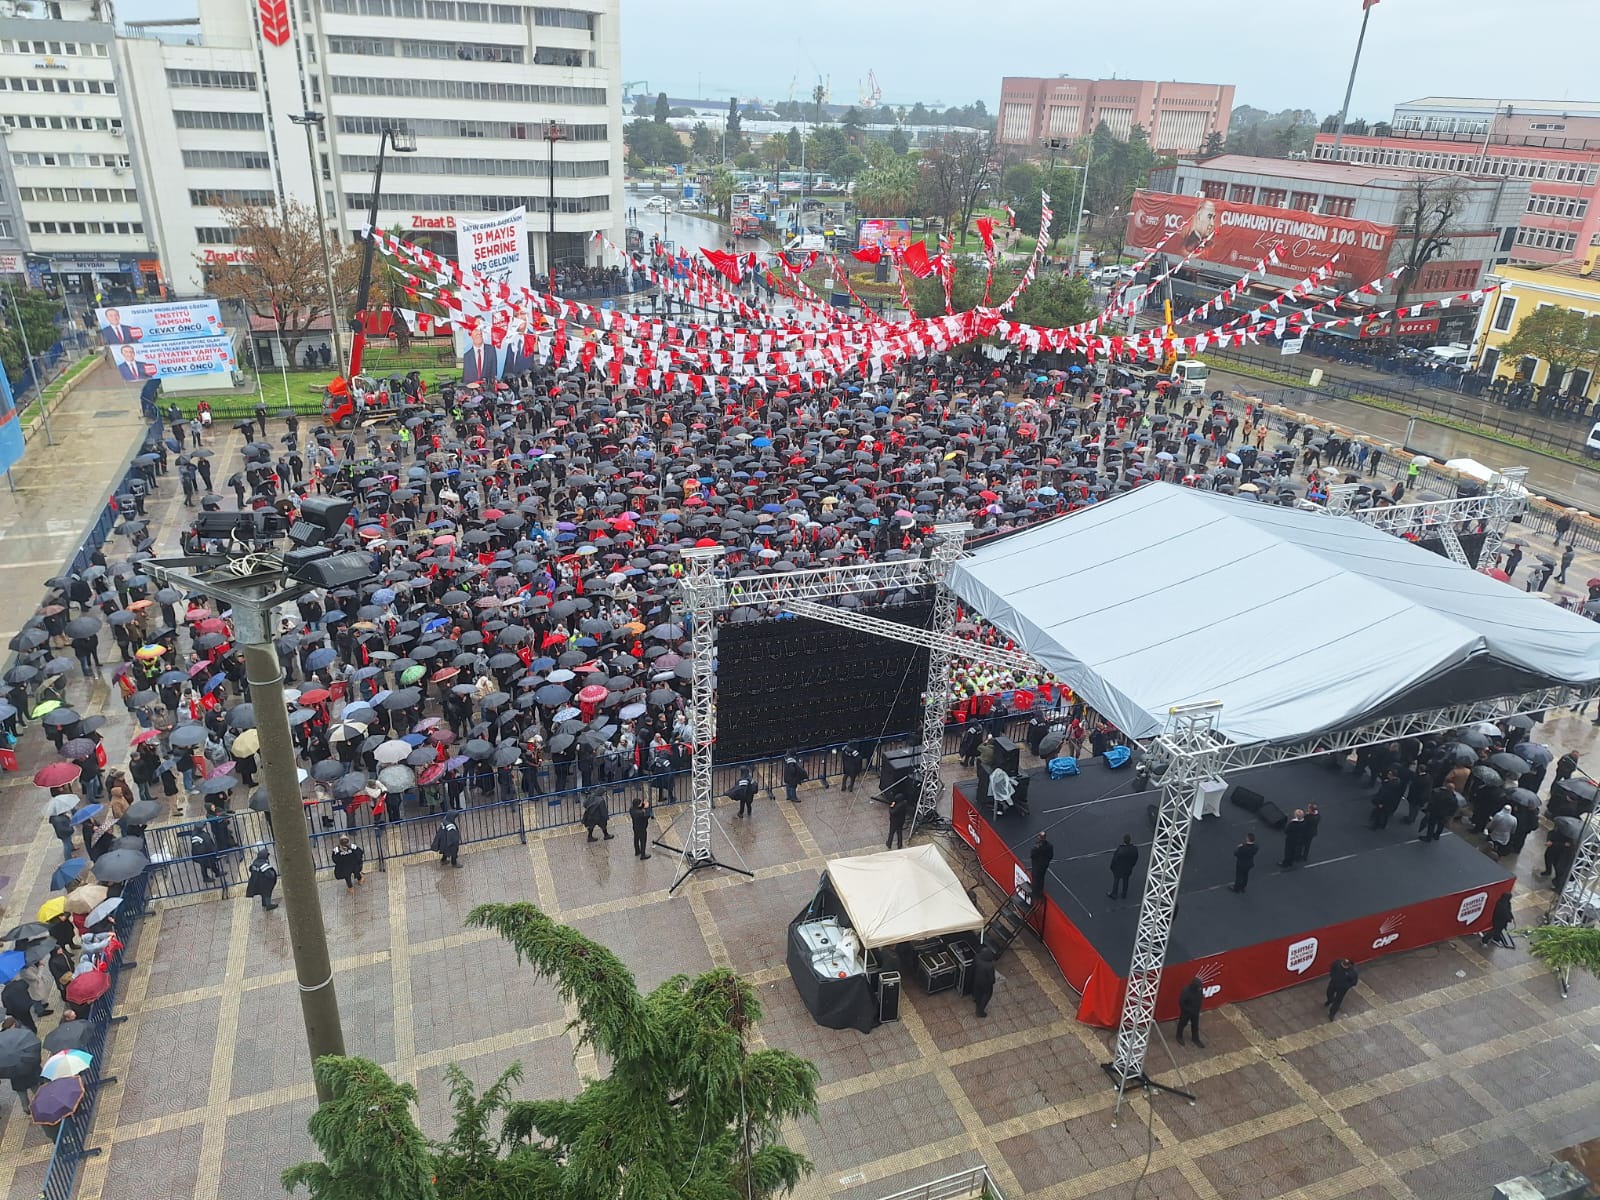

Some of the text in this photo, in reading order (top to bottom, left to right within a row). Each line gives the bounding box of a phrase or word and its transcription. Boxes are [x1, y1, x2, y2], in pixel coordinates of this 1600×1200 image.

[412, 216, 445, 228] Ziraat
[472, 226, 516, 245] 19 MAYIS
[1221, 211, 1385, 250] CUMHURİYETİMİZİN 100. YILI
[474, 240, 516, 262] ŞEHRİNE
[1292, 239, 1332, 258] Olsun
[472, 262, 487, 272] HOŞ
[488, 253, 520, 268] GELDİNİZ
[154, 310, 190, 320] ENSTİTÜ
[156, 318, 191, 326] SAMSUN
[1385, 323, 1432, 333] kkoreç
[149, 326, 175, 335] CEVAT
[178, 323, 202, 332] ÖNCÜ
[157, 350, 191, 358] FİYATINI
[162, 365, 187, 373] CEVAT
[1372, 933, 1400, 948] CHP
[1290, 954, 1313, 967] SAMSUN
[1202, 985, 1221, 998] HP
